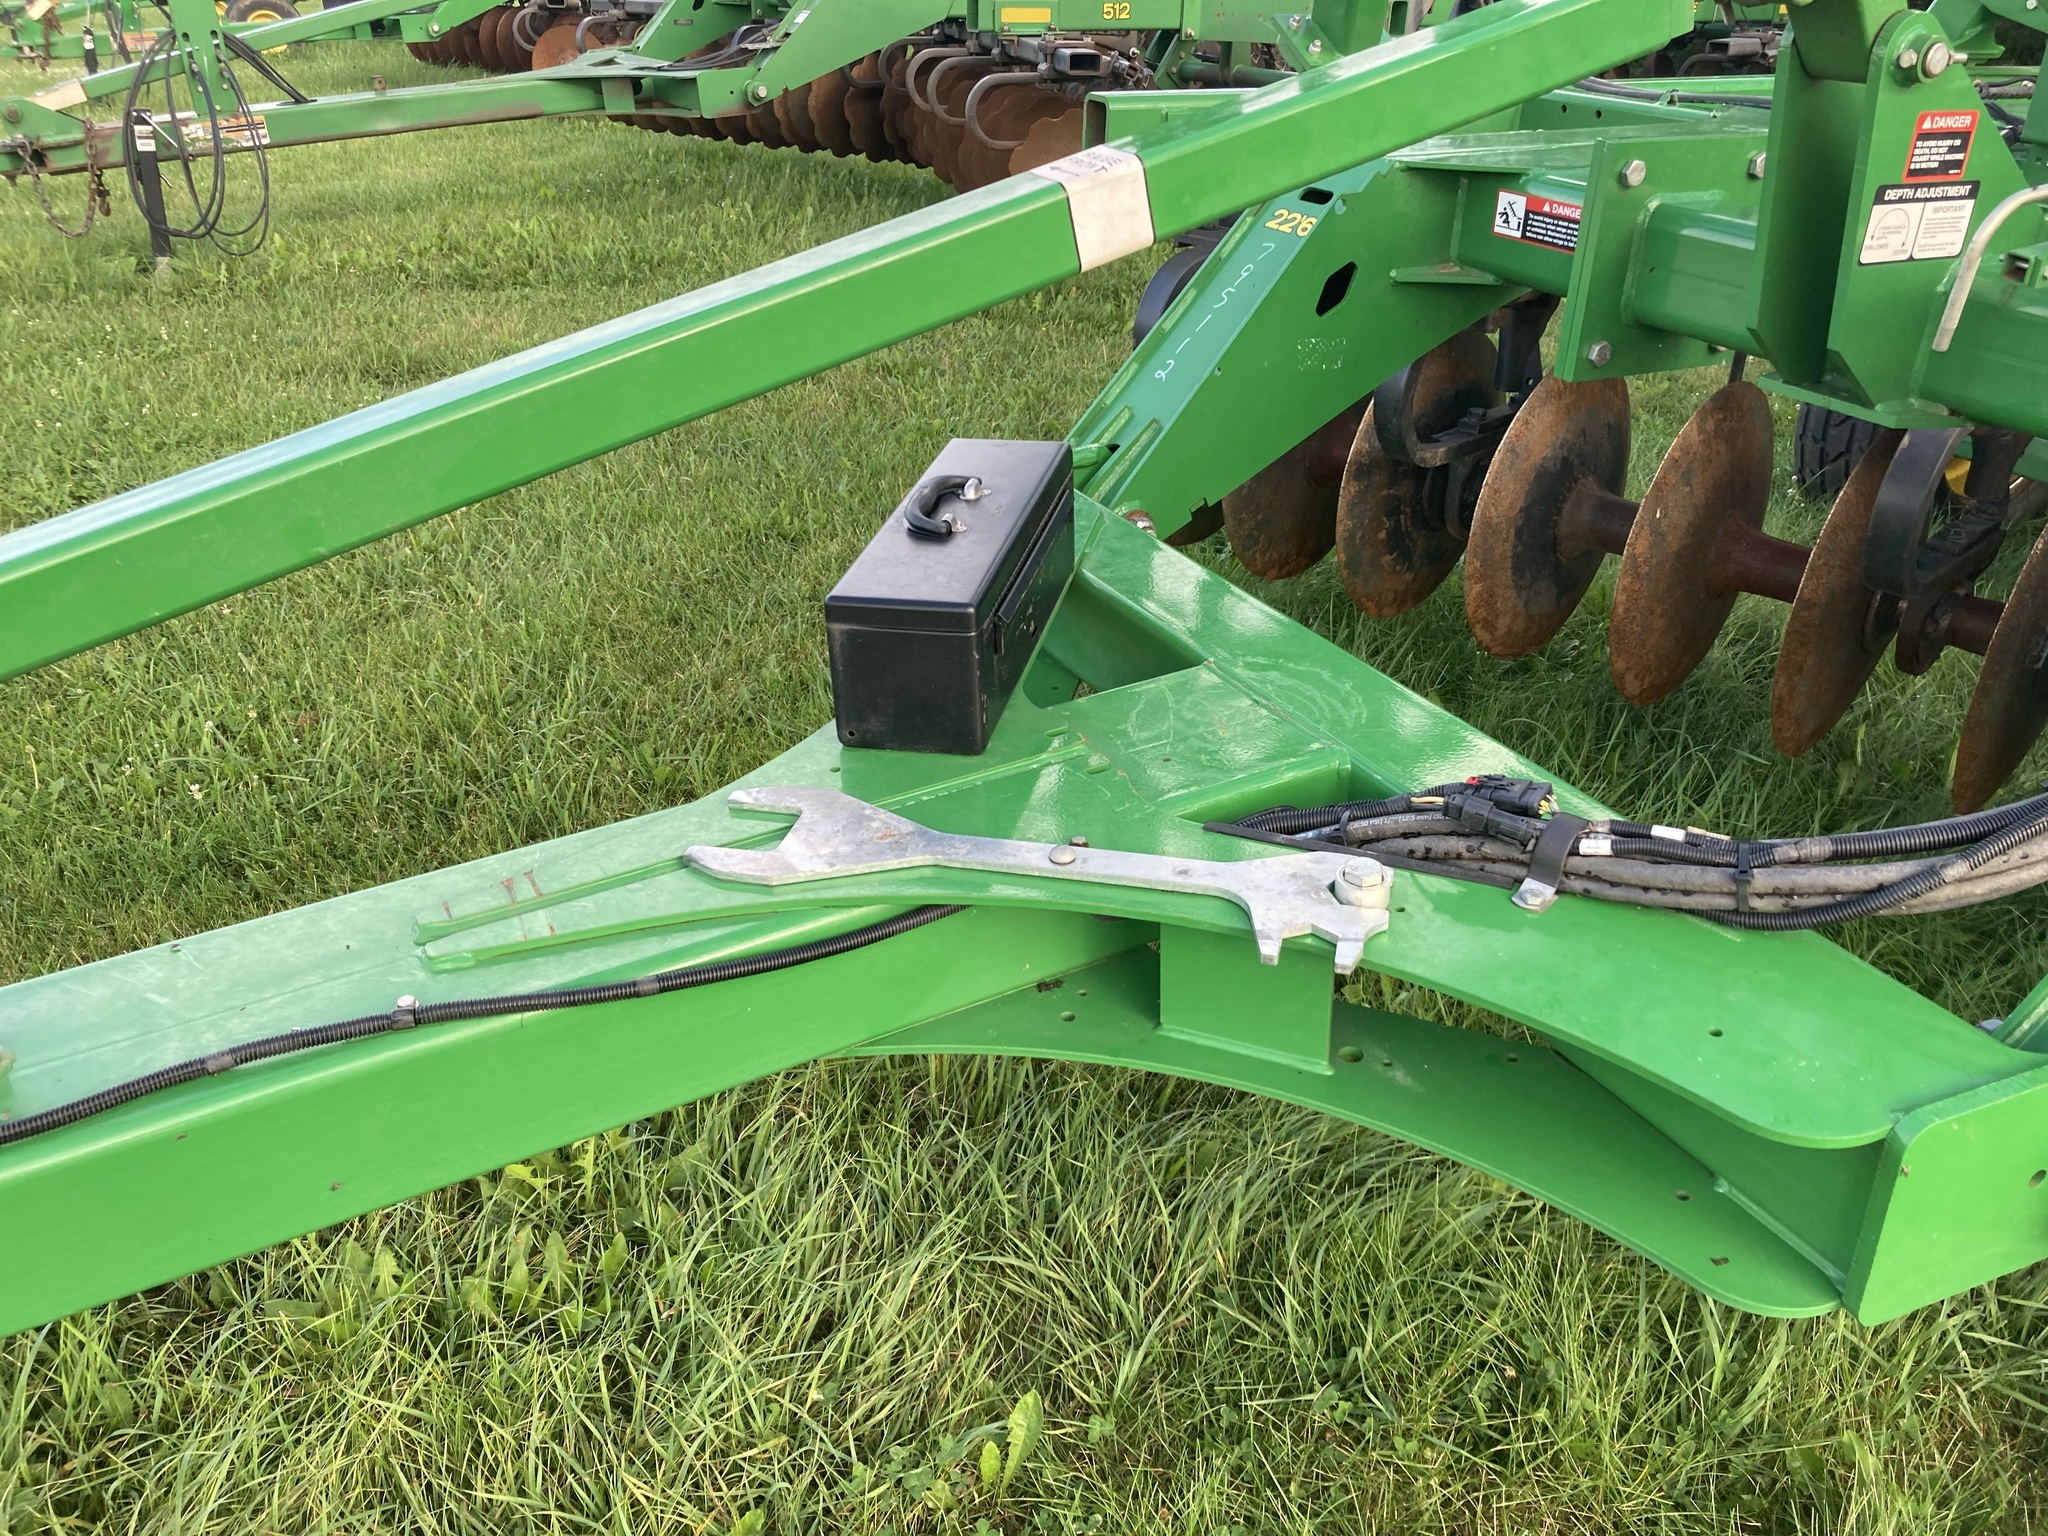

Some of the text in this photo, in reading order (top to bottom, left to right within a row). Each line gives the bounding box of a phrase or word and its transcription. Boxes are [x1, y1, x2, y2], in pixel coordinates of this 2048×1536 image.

[1103, 2, 1131, 20] 512
[1932, 116, 1972, 128] DANGER
[1884, 185, 1972, 200] DEPTH ADJUSTMENT
[1552, 204, 1582, 219] DANGE
[1932, 205, 1966, 214] IMPORTANT
